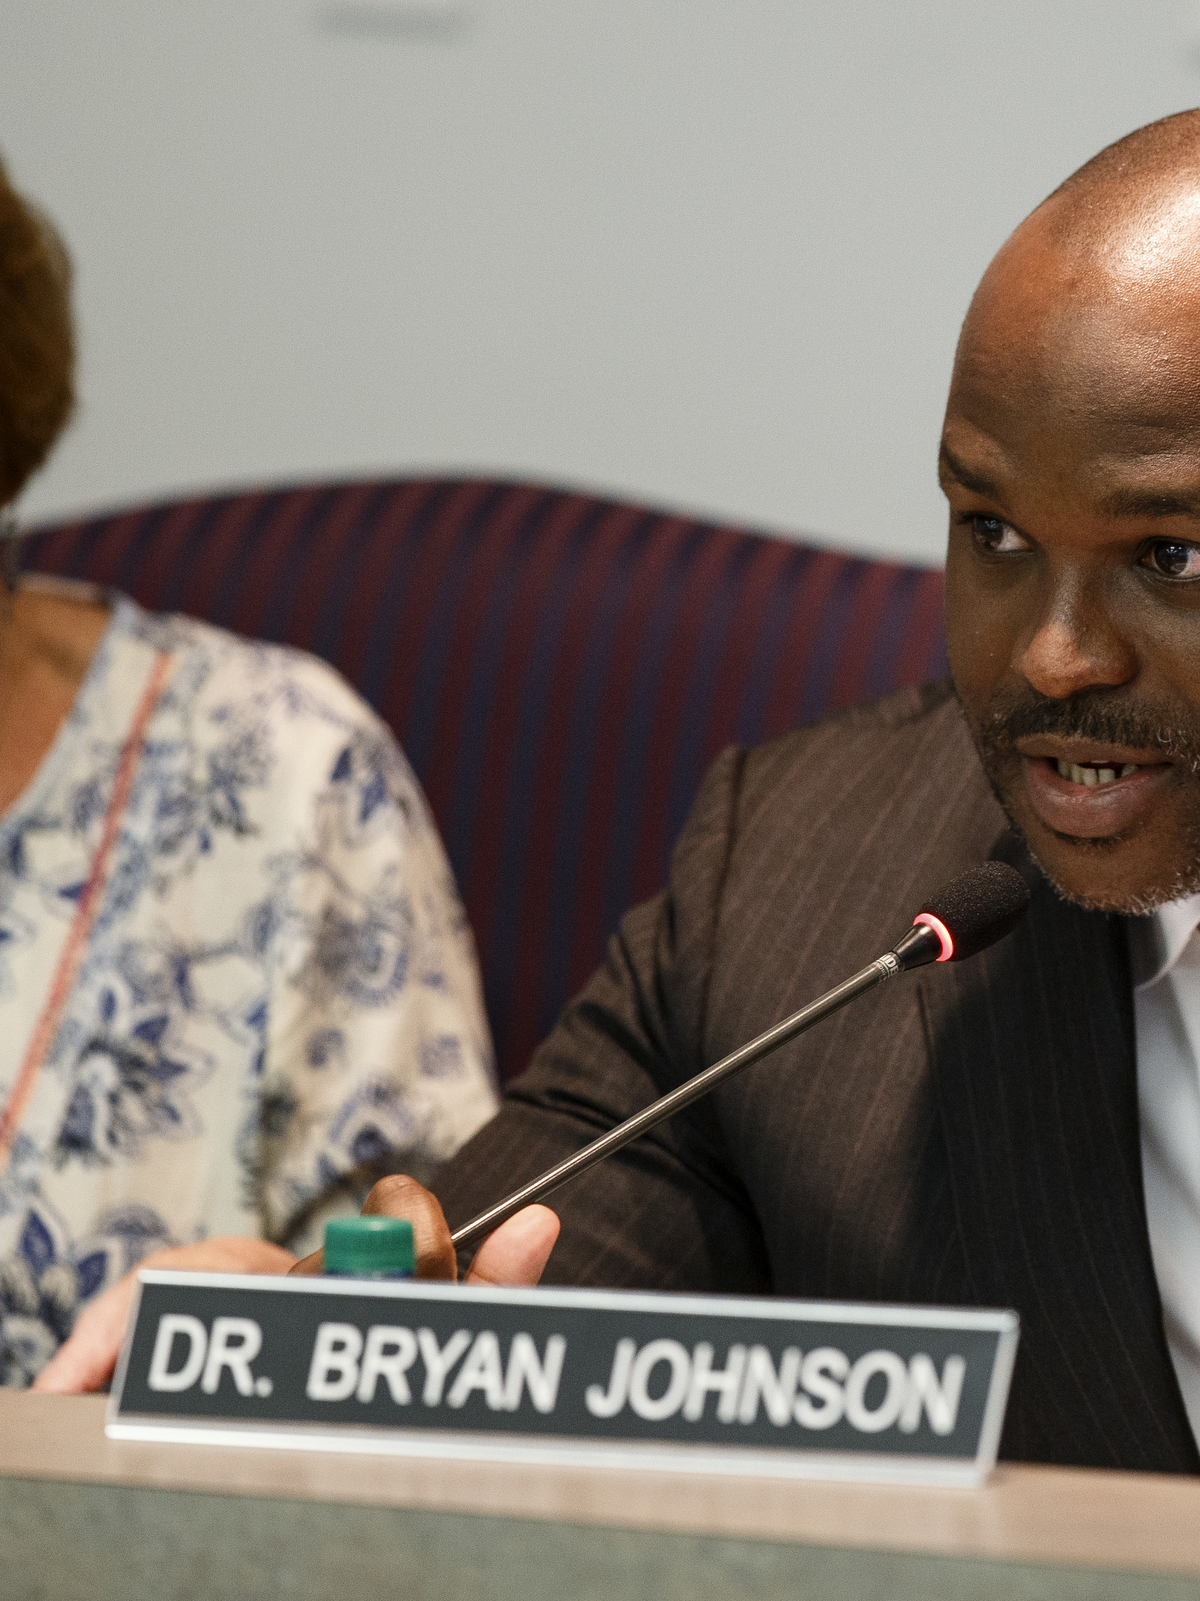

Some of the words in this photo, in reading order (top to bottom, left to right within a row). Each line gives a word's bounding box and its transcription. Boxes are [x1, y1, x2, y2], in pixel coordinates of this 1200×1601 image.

[149, 1313, 274, 1398] DR.
[307, 1322, 568, 1414] BRYAN
[585, 1337, 967, 1435] JOHNSON
